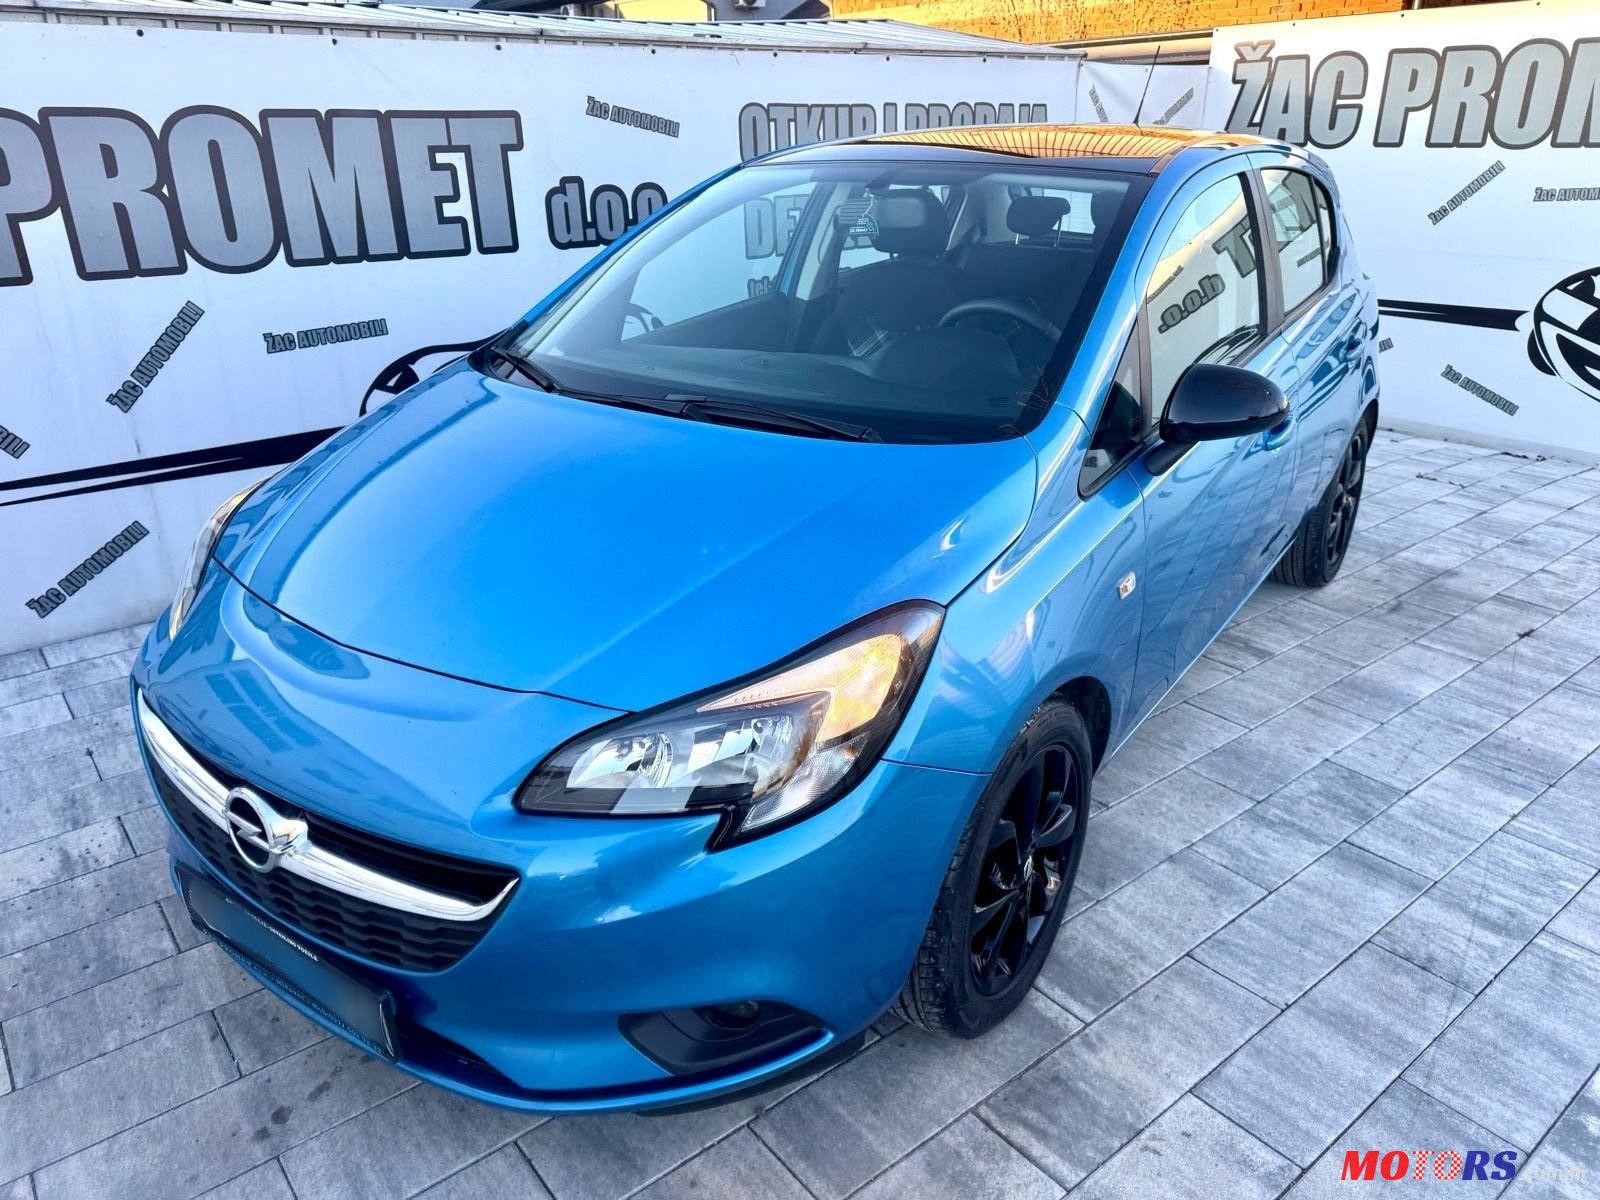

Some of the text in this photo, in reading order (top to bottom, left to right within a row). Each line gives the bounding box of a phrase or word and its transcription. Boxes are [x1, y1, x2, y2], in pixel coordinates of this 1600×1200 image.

[585, 95, 680, 138] ŽAC AUTOMOBILI
[1224, 40, 1369, 149] ŽAC
[1427, 160, 1506, 226] ŽAC AUTOMOBILI
[1533, 187, 1600, 202] ŽAC AUTOM
[105, 300, 205, 414] ŽAC AUTOMOBILI
[262, 318, 389, 354] ŽAC AUTOMOBILI
[1440, 364, 1520, 417] ŽAC AUTOMOBILI
[24, 520, 150, 619] ŽAC AUTOMOBILI
